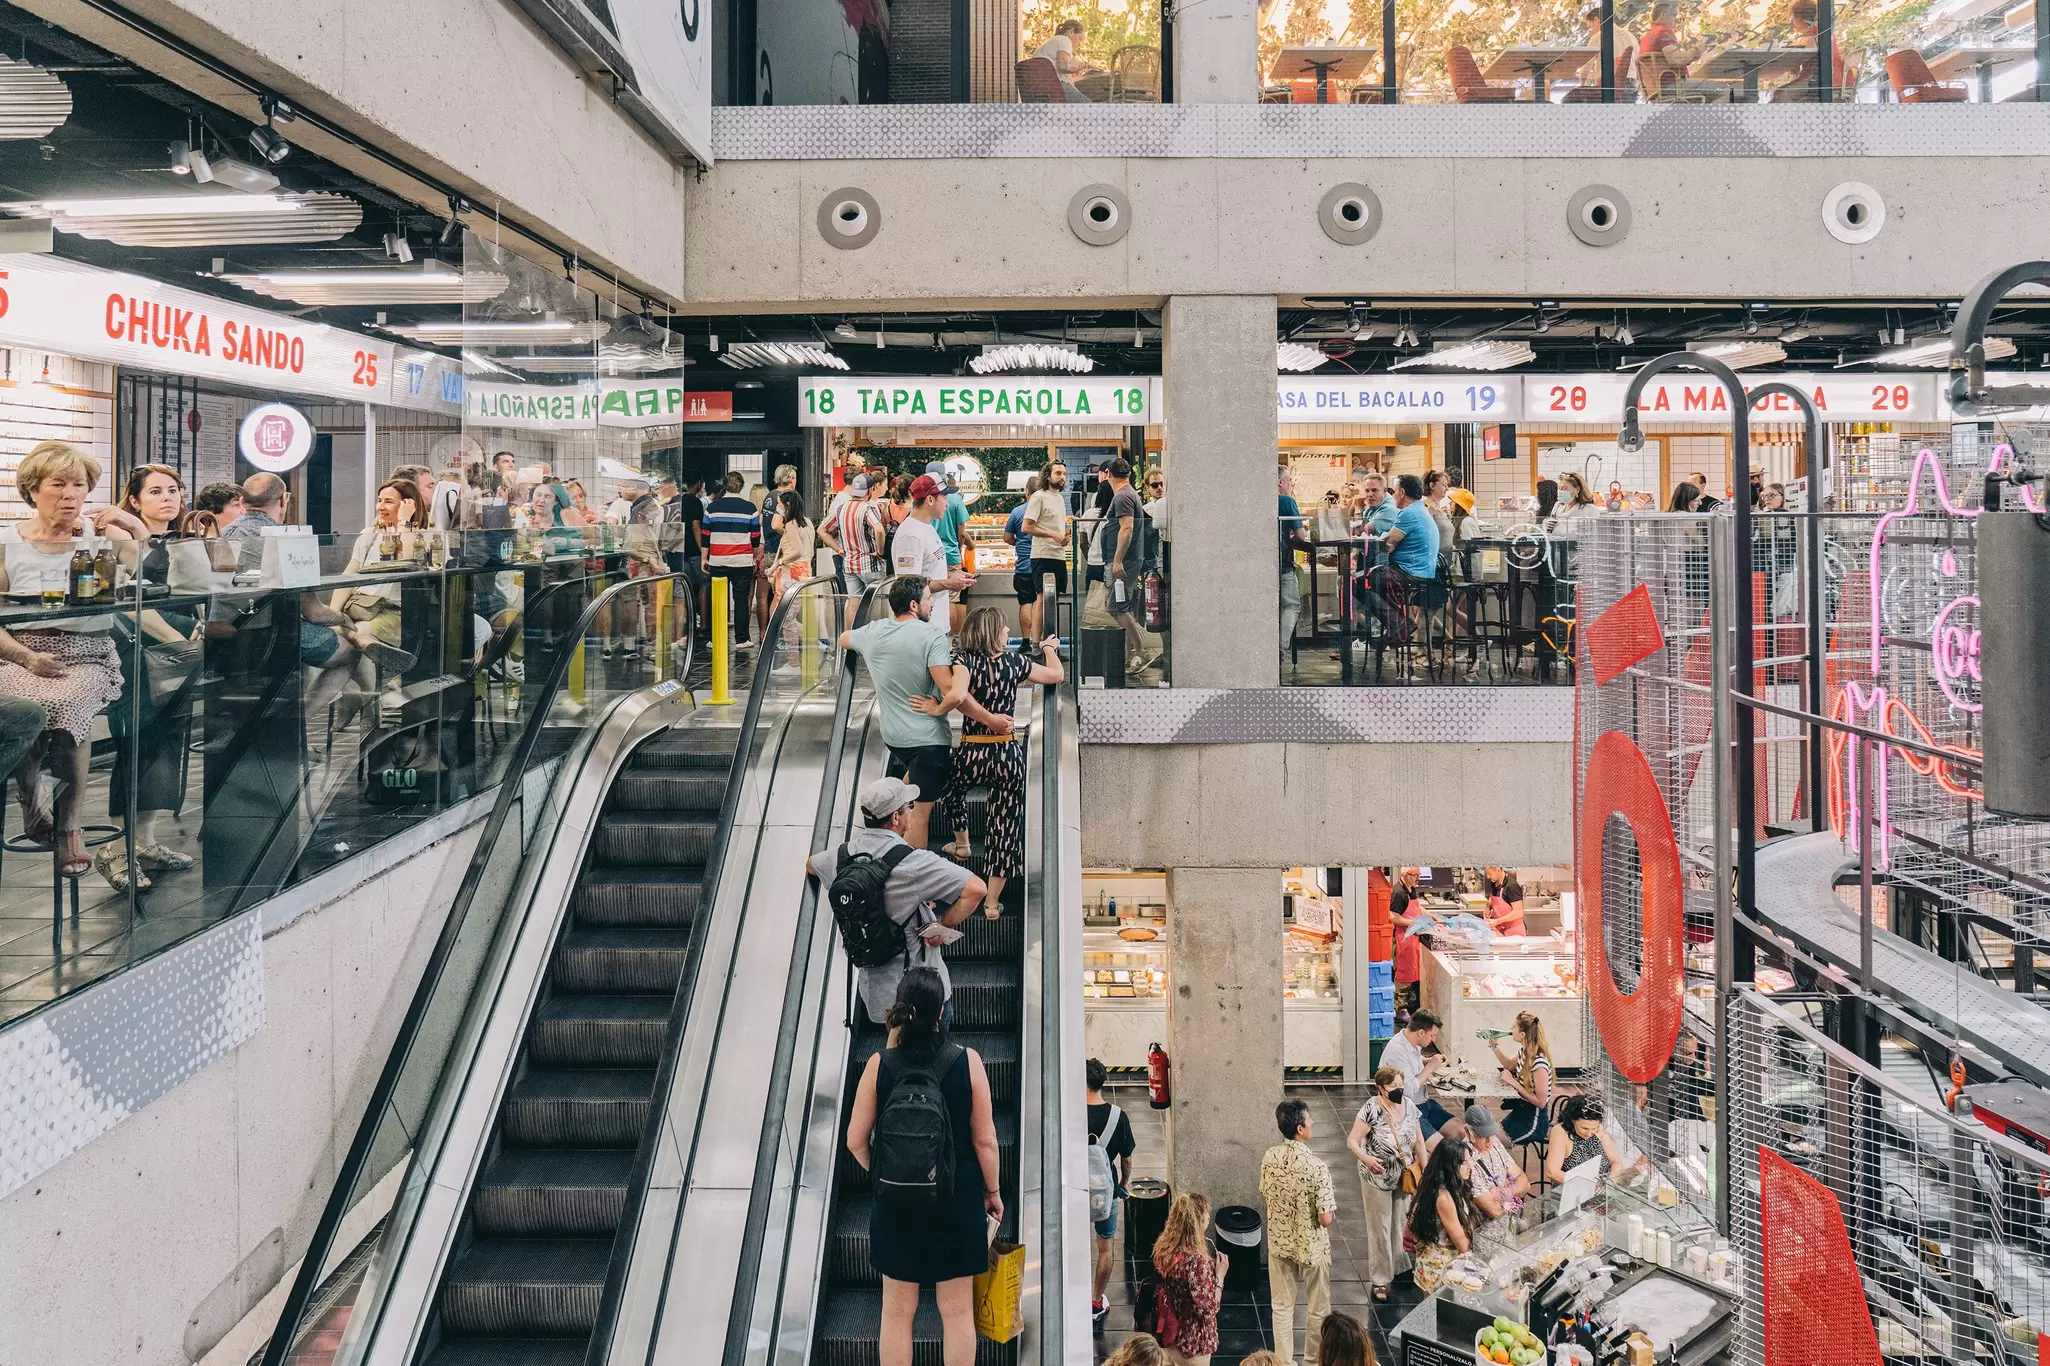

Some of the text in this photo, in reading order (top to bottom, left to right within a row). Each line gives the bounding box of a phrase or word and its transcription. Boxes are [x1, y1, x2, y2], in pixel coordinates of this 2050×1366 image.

[0, 270, 378, 387] 5 CHUKA SANDO 25
[408, 363, 425, 395] 17
[804, 388, 1144, 415] 18 TAPA ESPAÑOLA 18
[1277, 385, 1496, 412] ASA DEL BACALAO 19
[1550, 385, 1909, 412] 20 LA MAUEA 20
[382, 768, 417, 788] GLO
